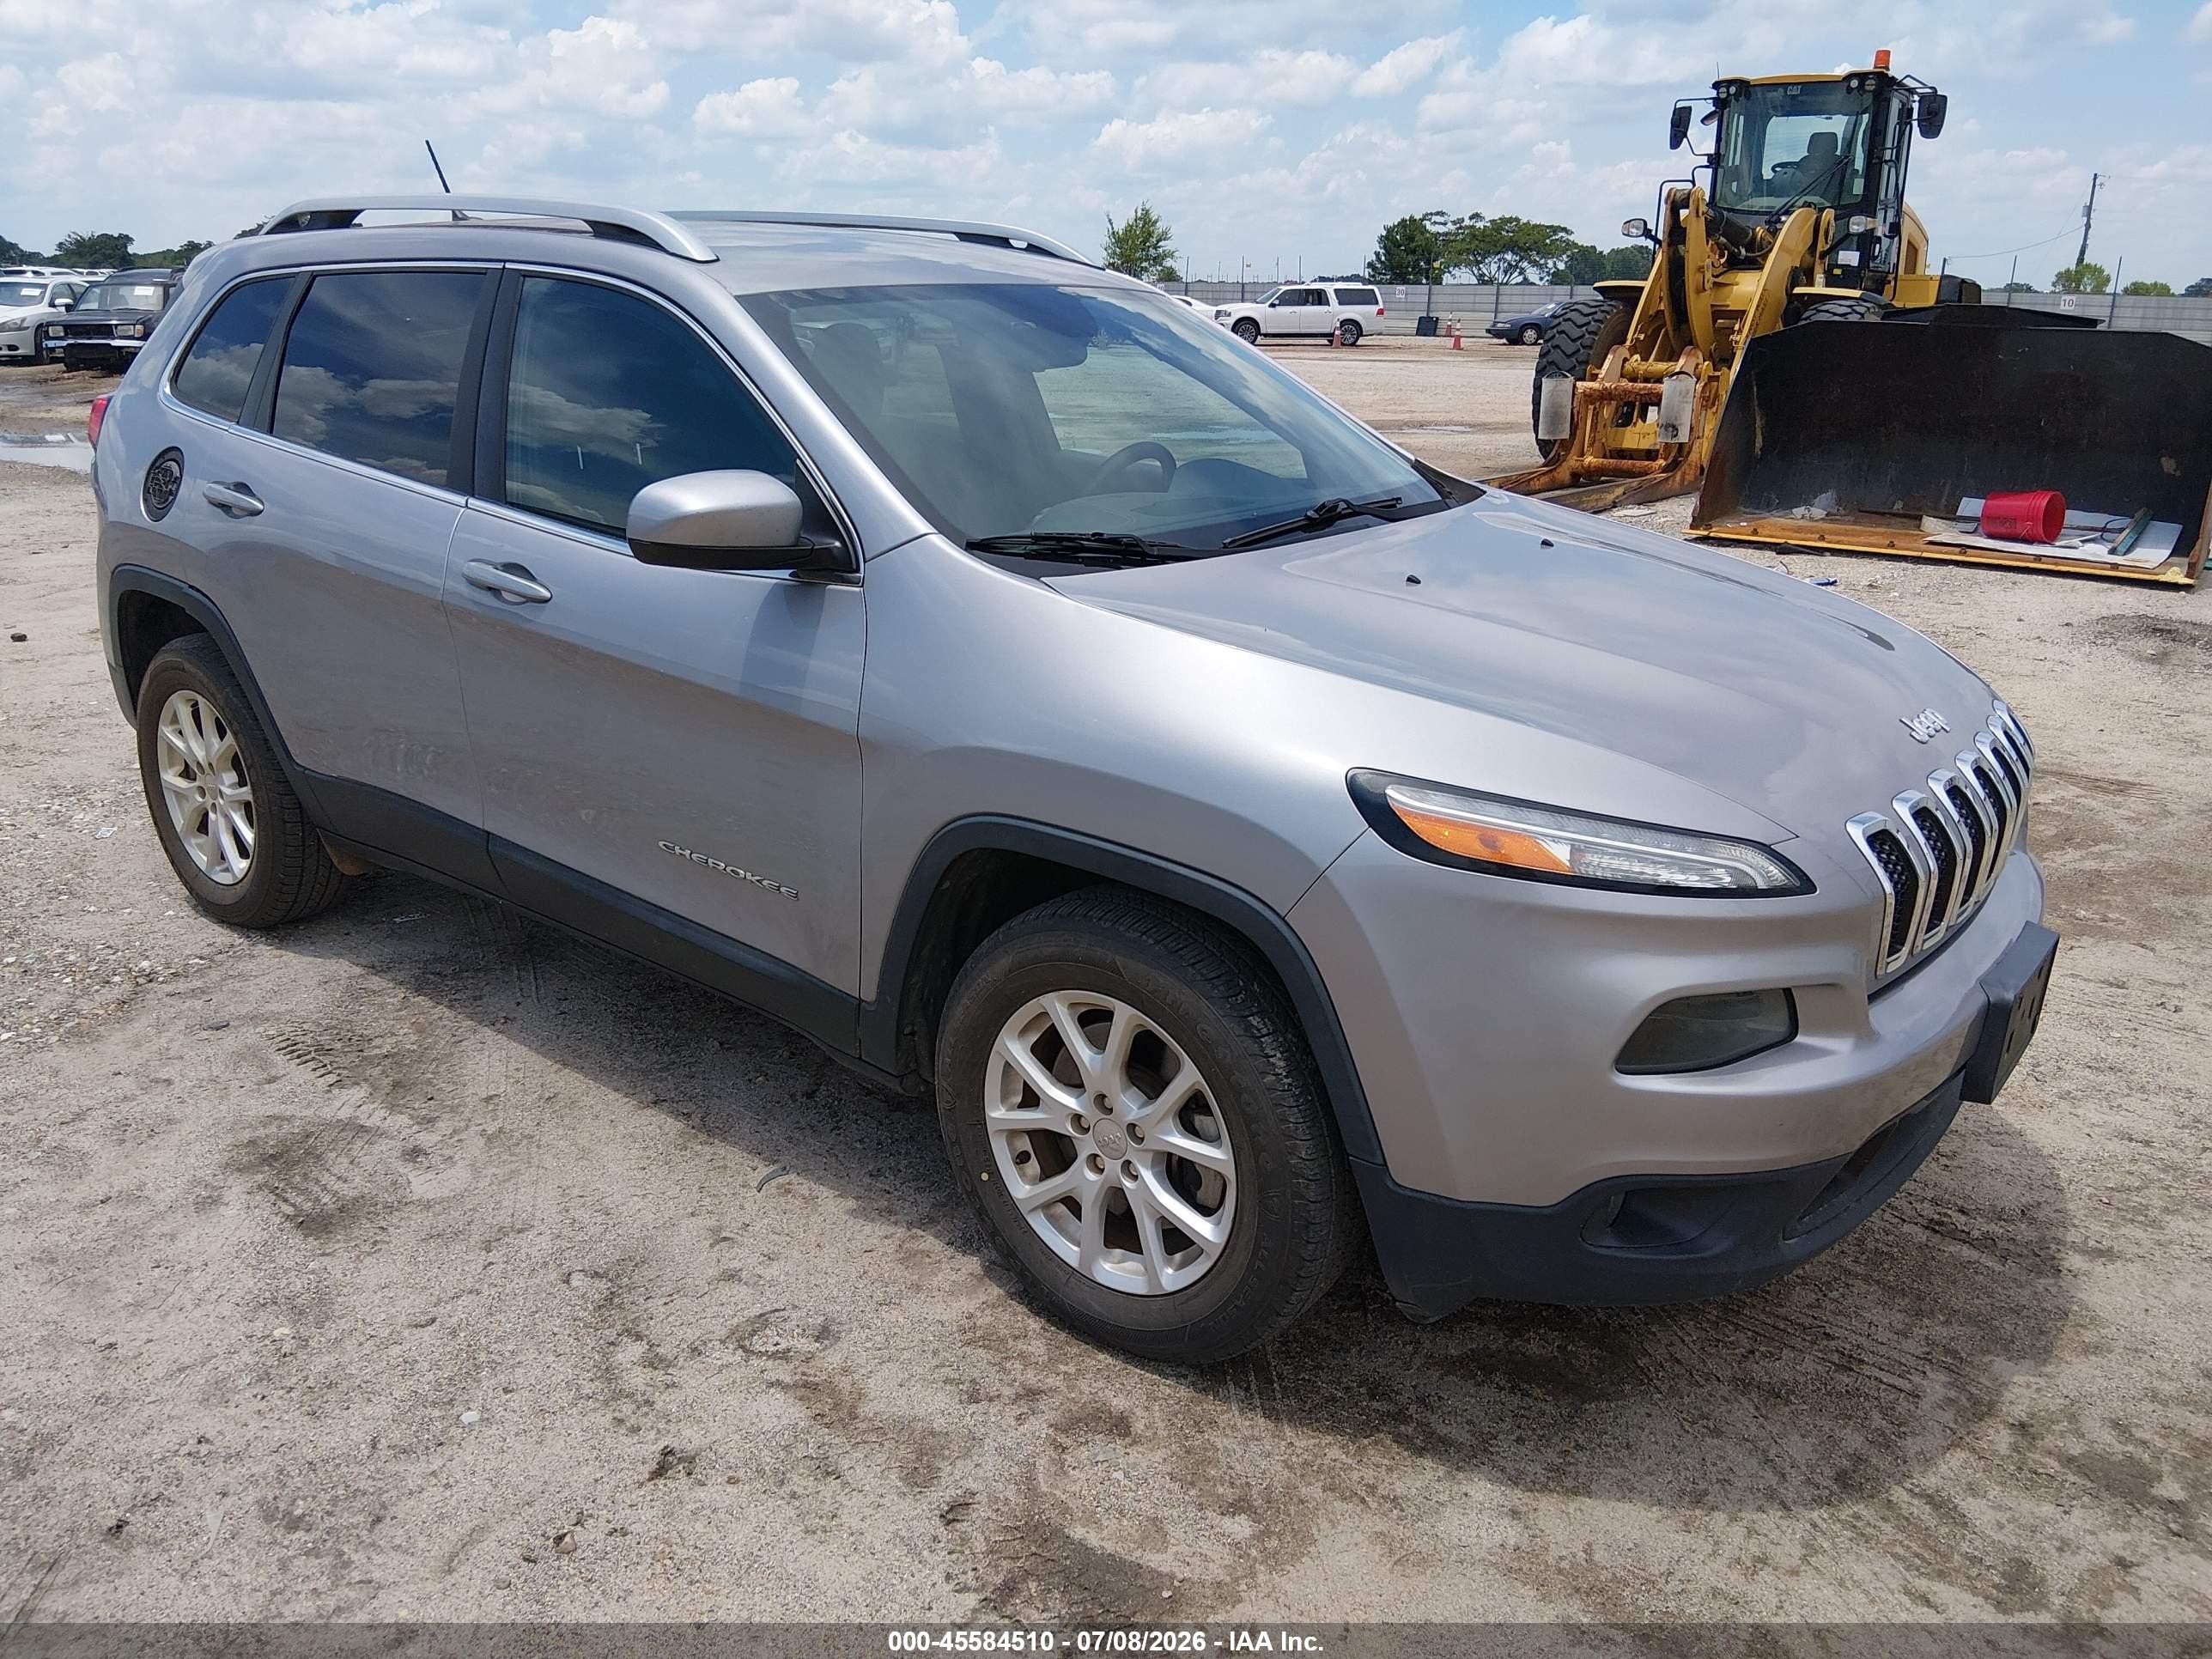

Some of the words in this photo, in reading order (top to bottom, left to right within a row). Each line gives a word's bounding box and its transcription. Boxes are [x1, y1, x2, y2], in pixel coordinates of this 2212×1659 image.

[1786, 85, 1802, 95] CAT
[2062, 298, 2075, 307] 10
[1899, 708, 1952, 744] Jeep
[658, 839, 799, 901] CHEROKEE
